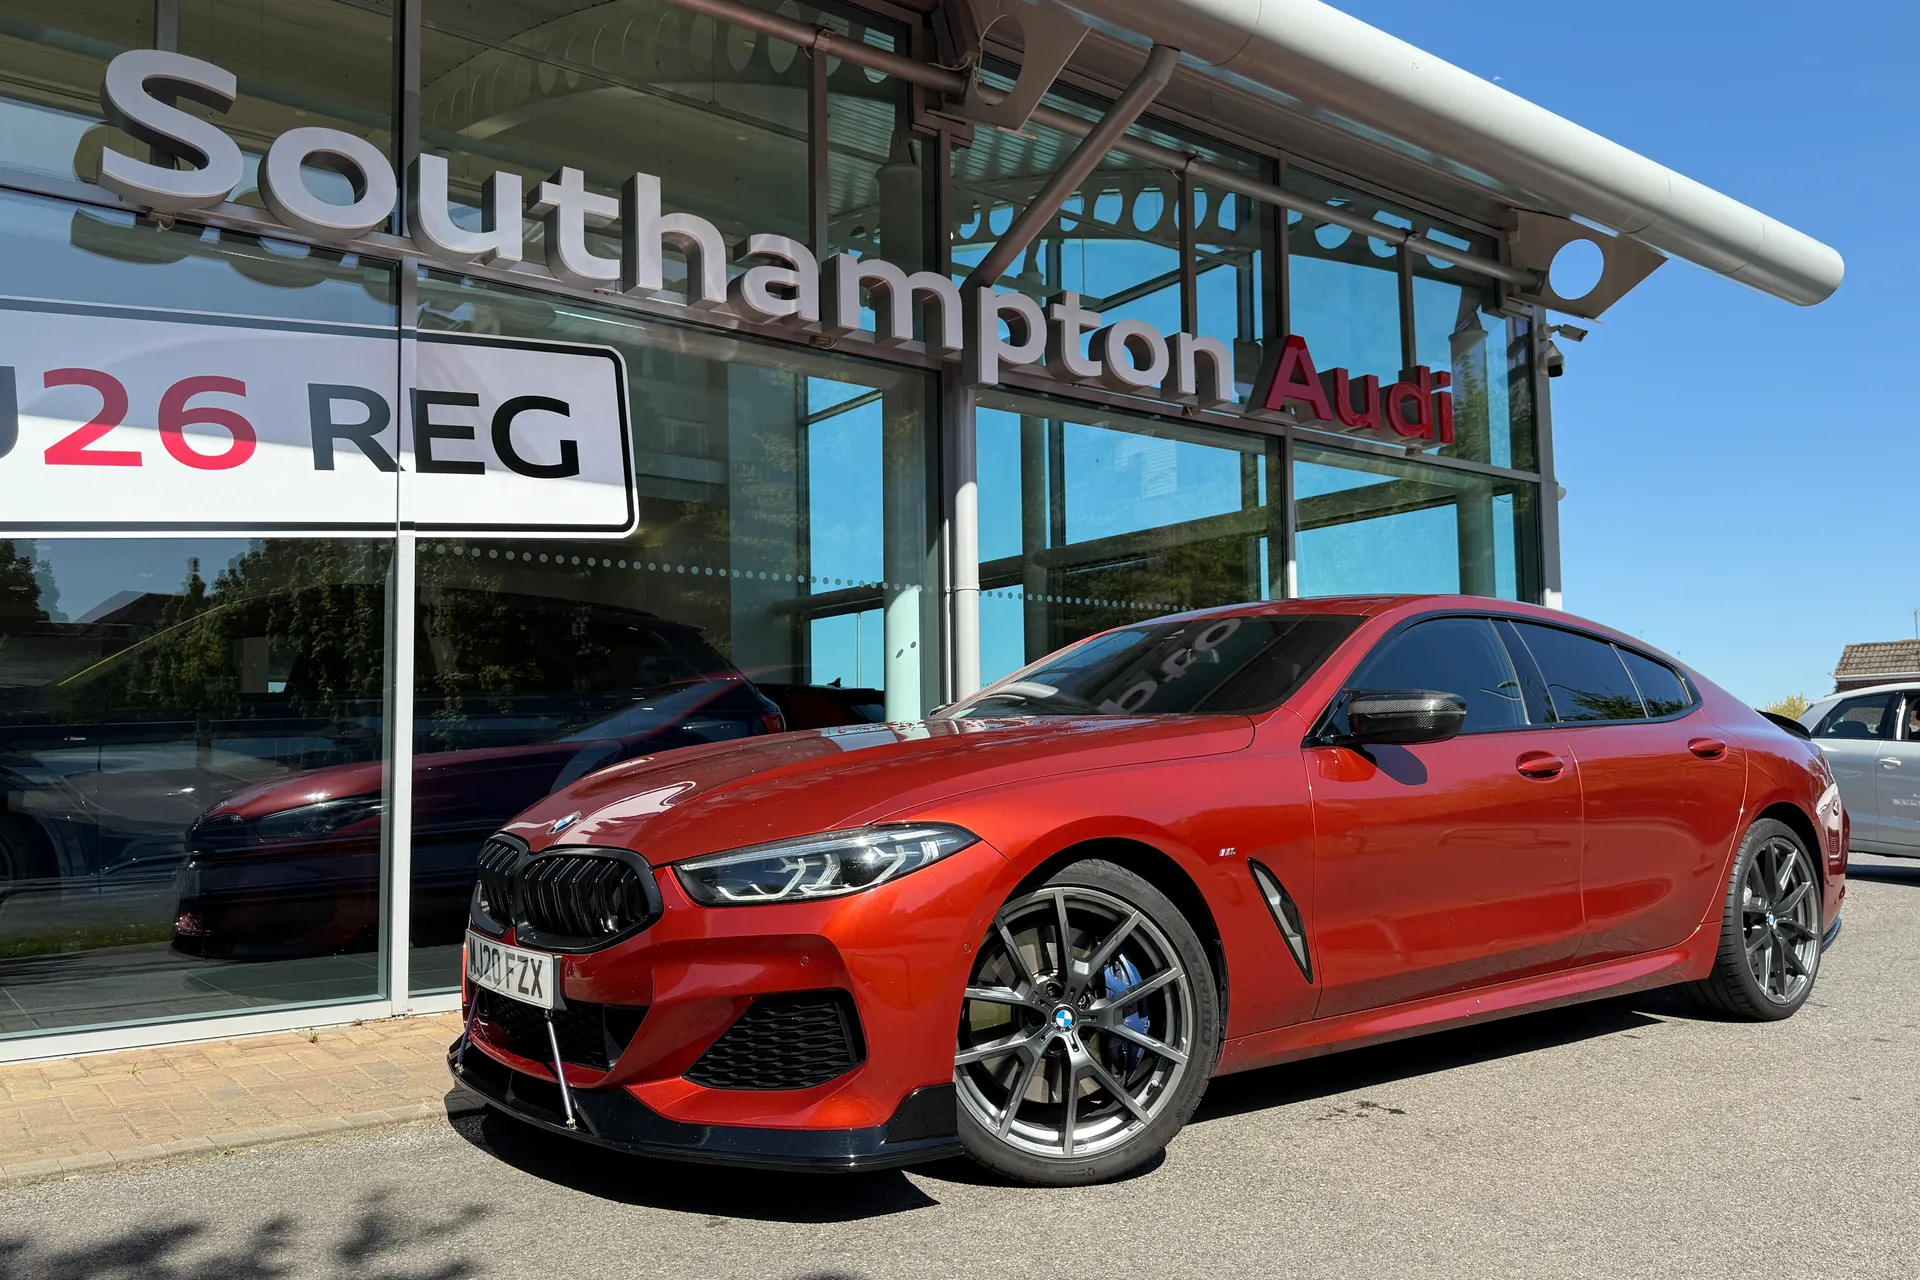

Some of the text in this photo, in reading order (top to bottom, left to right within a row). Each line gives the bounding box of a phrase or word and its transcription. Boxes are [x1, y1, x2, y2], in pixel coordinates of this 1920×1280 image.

[101, 49, 1455, 444] Southampton Audi
[0, 366, 580, 479] 26 REG
[505, 951, 543, 999] FZX
